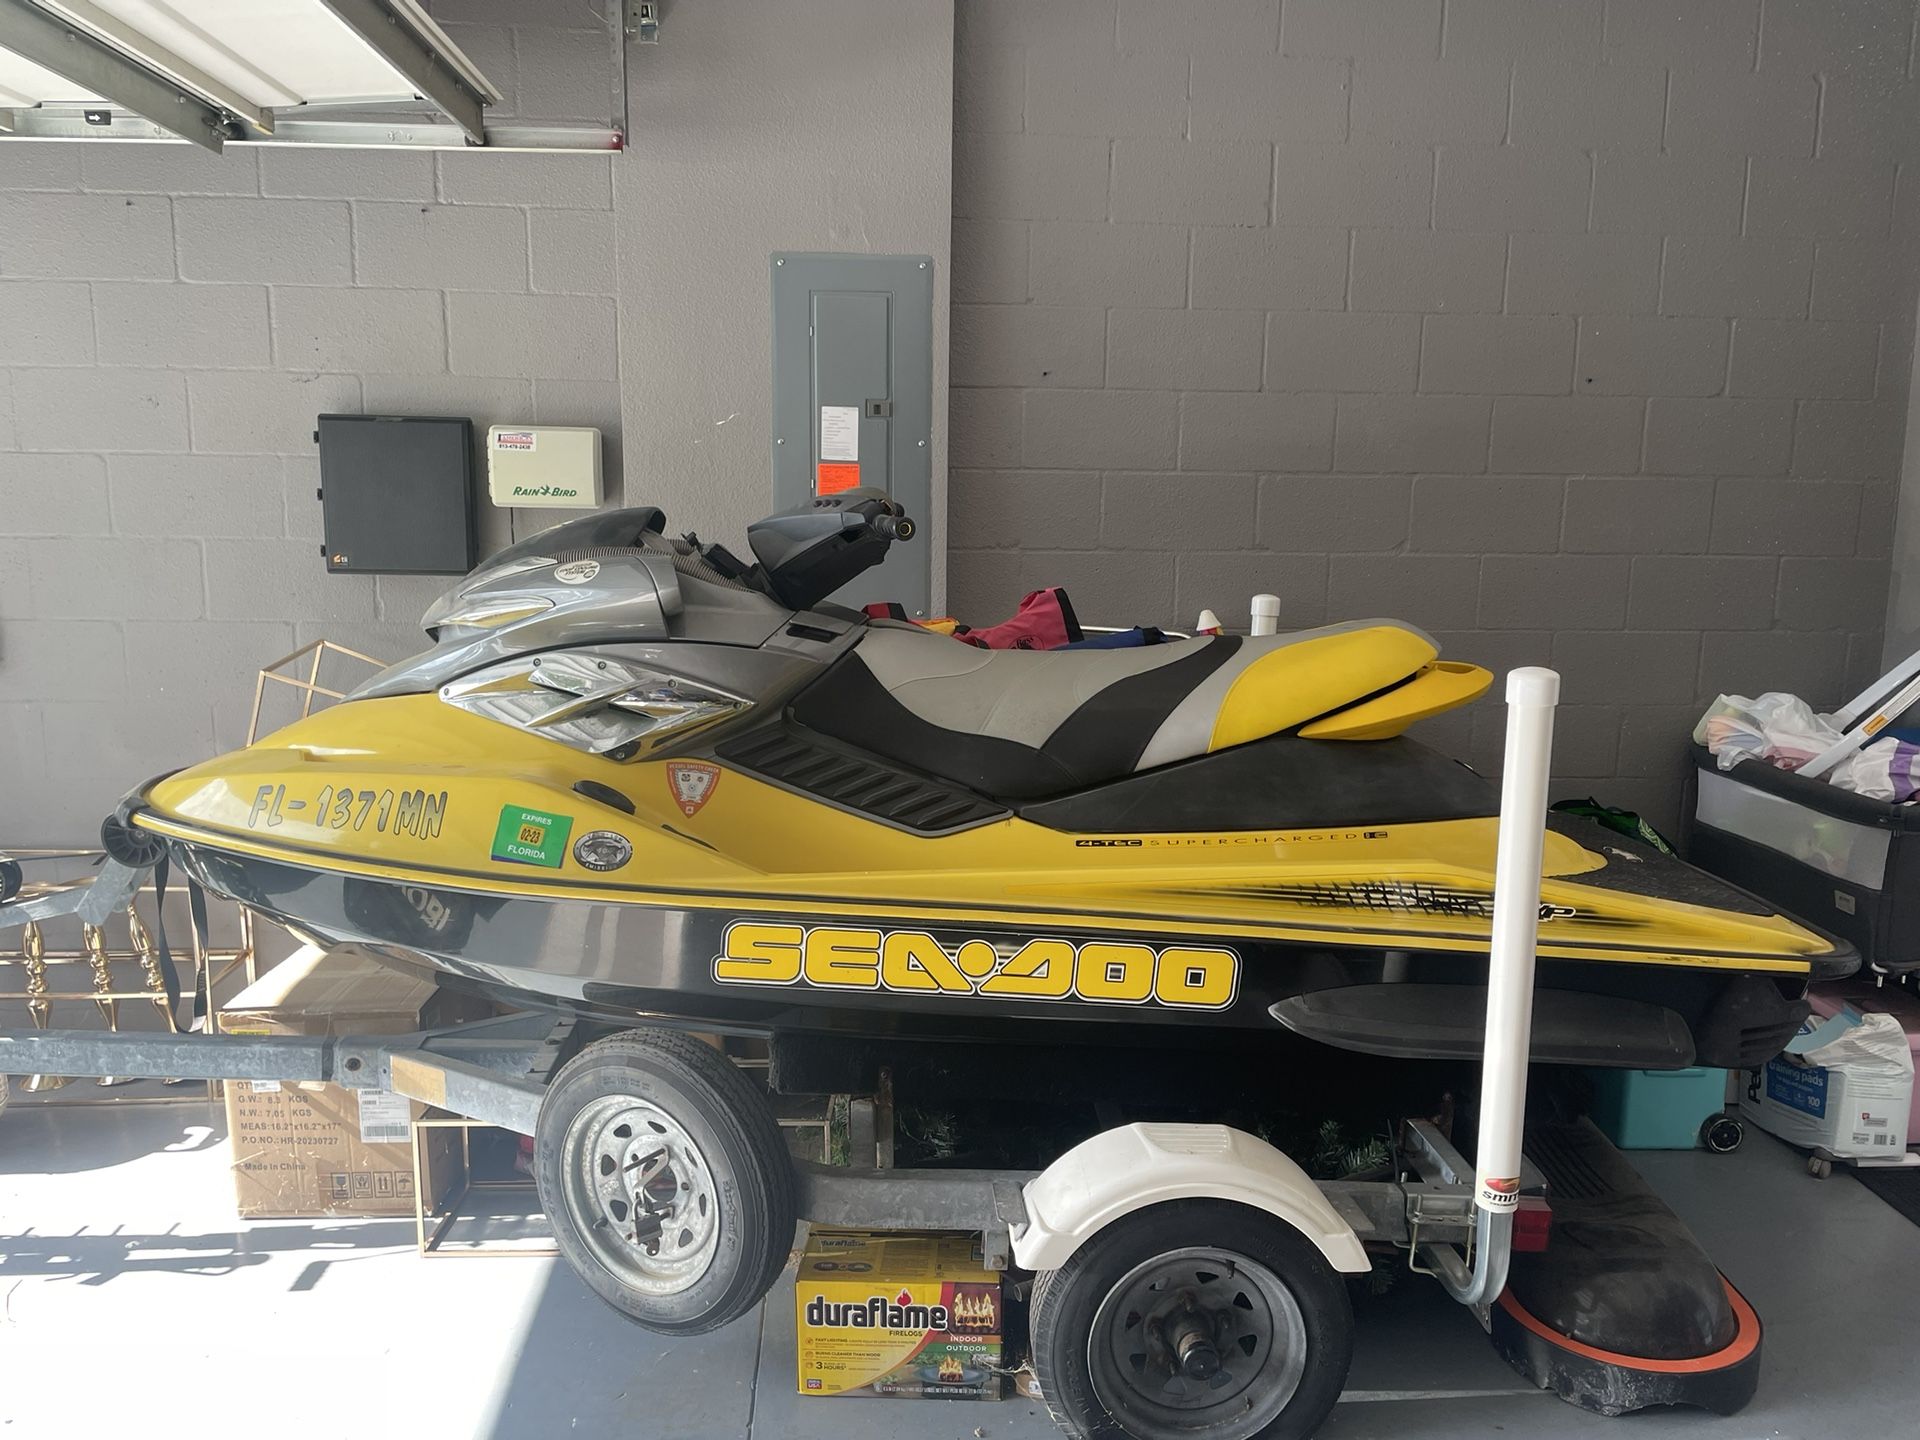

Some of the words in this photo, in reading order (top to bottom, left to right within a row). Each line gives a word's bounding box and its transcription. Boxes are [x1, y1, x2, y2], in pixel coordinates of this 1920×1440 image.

[551, 487, 577, 497] BIRD
[521, 813, 553, 827] EXPIRES
[520, 827, 541, 845] 02-23
[1150, 833, 1358, 846] SUPERCHARGED
[507, 844, 546, 860] FLORIDA
[1801, 1072, 1824, 1087] pads
[288, 1095, 309, 1103] KGS
[1807, 1095, 1821, 1108] 100
[292, 1109, 312, 1117] KGS
[244, 1163, 268, 1171] Made
[280, 1163, 306, 1171] China
[806, 1295, 949, 1330] duraflame
[815, 1361, 823, 1370] 3
